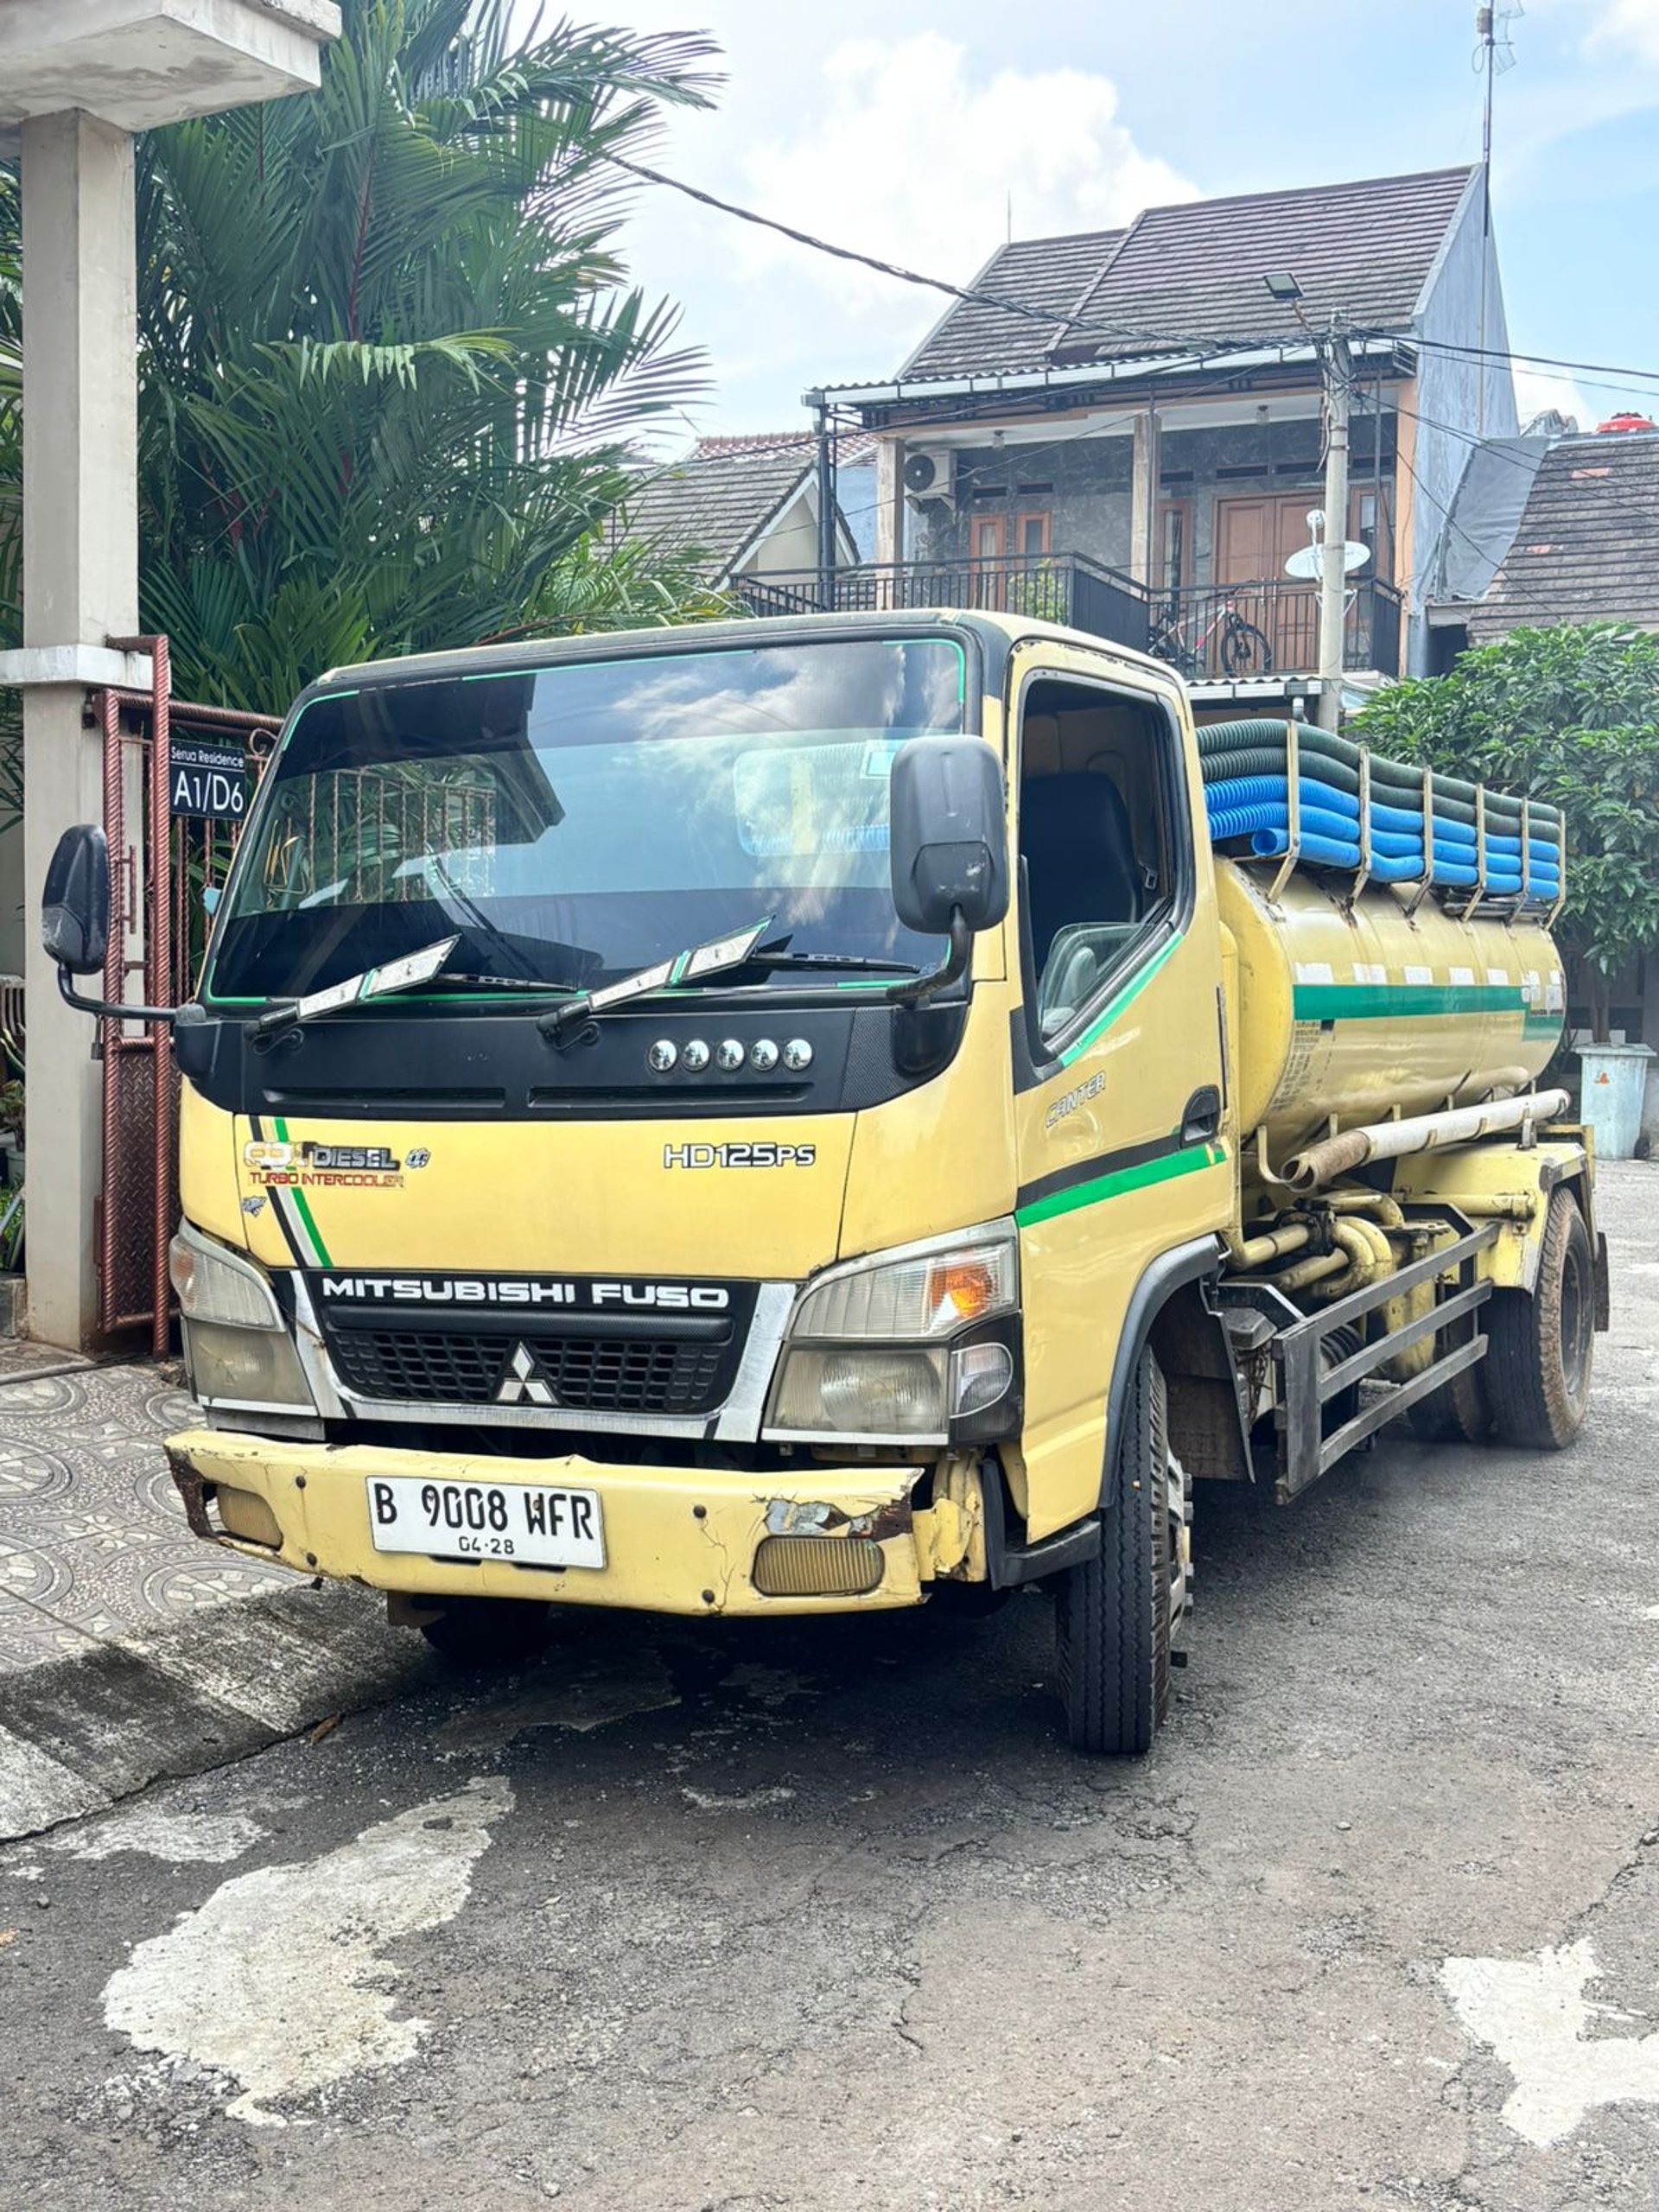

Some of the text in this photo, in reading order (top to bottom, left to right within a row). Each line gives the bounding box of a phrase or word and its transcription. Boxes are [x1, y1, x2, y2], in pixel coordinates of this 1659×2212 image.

[171, 746, 245, 768] Serua Residence
[174, 771, 244, 813] A1/D6
[312, 1146, 400, 1172] DIESEL
[664, 1142, 817, 1168] HD125PS
[250, 1172, 404, 1188] TURBO INTERCOOLER
[322, 1277, 730, 1309] MITSUBISHI FUSO
[374, 1483, 594, 1541] B 9008 WFR
